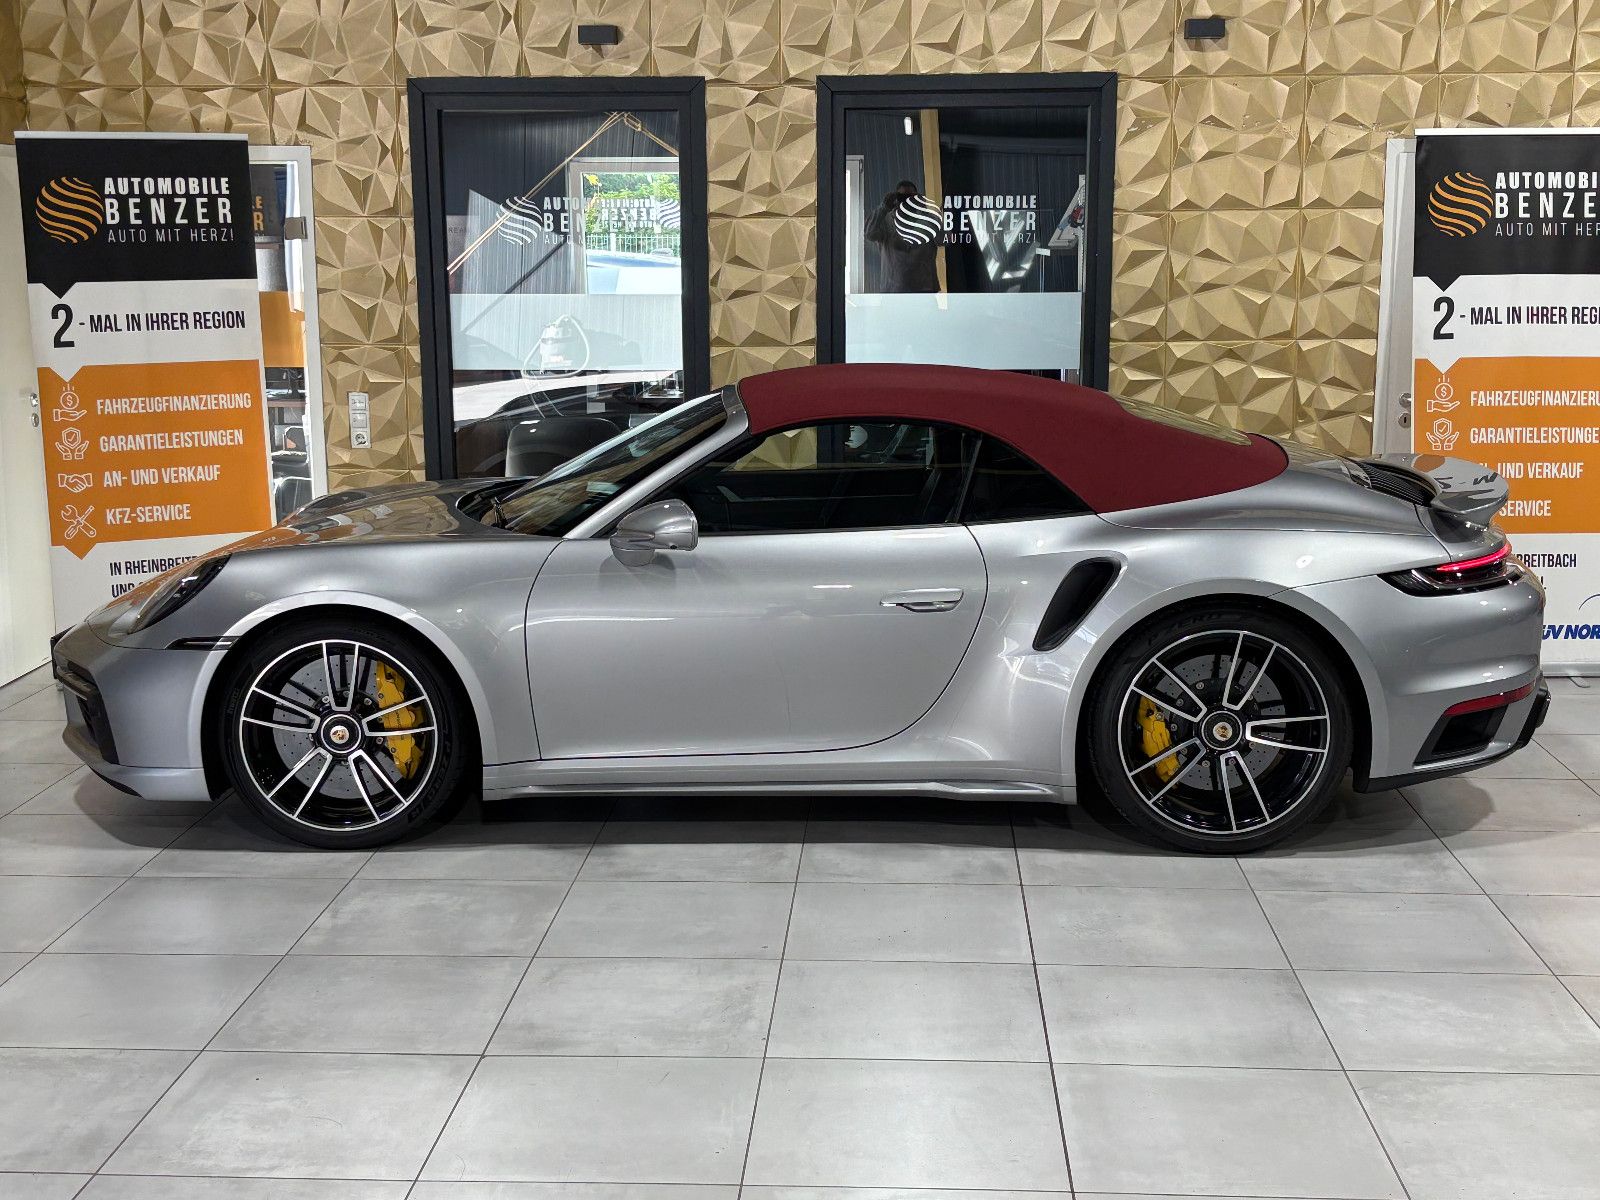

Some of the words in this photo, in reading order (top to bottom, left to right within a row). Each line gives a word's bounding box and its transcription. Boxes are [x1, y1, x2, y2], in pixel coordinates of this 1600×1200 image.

[104, 177, 230, 195] AUTOMOBILE
[1495, 171, 1598, 189] AUTOMOBI
[943, 195, 1037, 209] AUTOMOBILE
[1495, 191, 1597, 219] BENZE
[105, 198, 232, 225] BENZER
[943, 211, 1037, 232] BENZER
[1495, 222, 1534, 237] AUTO
[1542, 222, 1567, 237] MIT
[107, 229, 147, 243] AUTO
[156, 228, 181, 242] MIT
[190, 228, 234, 242] HERZ!
[943, 233, 972, 243] AUTO
[51, 303, 75, 349] 2
[89, 314, 122, 333] MAL
[125, 313, 142, 331] IN
[145, 312, 190, 331] IHRER
[193, 310, 246, 330] REGION
[1433, 296, 1455, 340] 2
[1470, 306, 1503, 325] MAL
[1507, 306, 1522, 325] IN
[1526, 306, 1567, 325] IHRER
[1572, 306, 1600, 324] REG
[96, 393, 252, 415] FAHRZEUGFINANZIERUNG
[1470, 390, 1600, 407] FAHRZEUGFINANZIERU
[99, 429, 244, 453] GARANTIELEISTUNGEN
[1470, 427, 1600, 444] GARANTIELEISTUNGE
[103, 470, 128, 488] AN-
[131, 468, 158, 486] UND
[160, 464, 222, 484] VERKAUF
[1497, 462, 1524, 479] UND
[1527, 462, 1584, 479] VERKAUF
[106, 504, 192, 525] KFZ-SERVICE
[1499, 500, 1552, 517] SERVICE
[110, 562, 122, 576] IN
[1564, 624, 1600, 640] NOR
